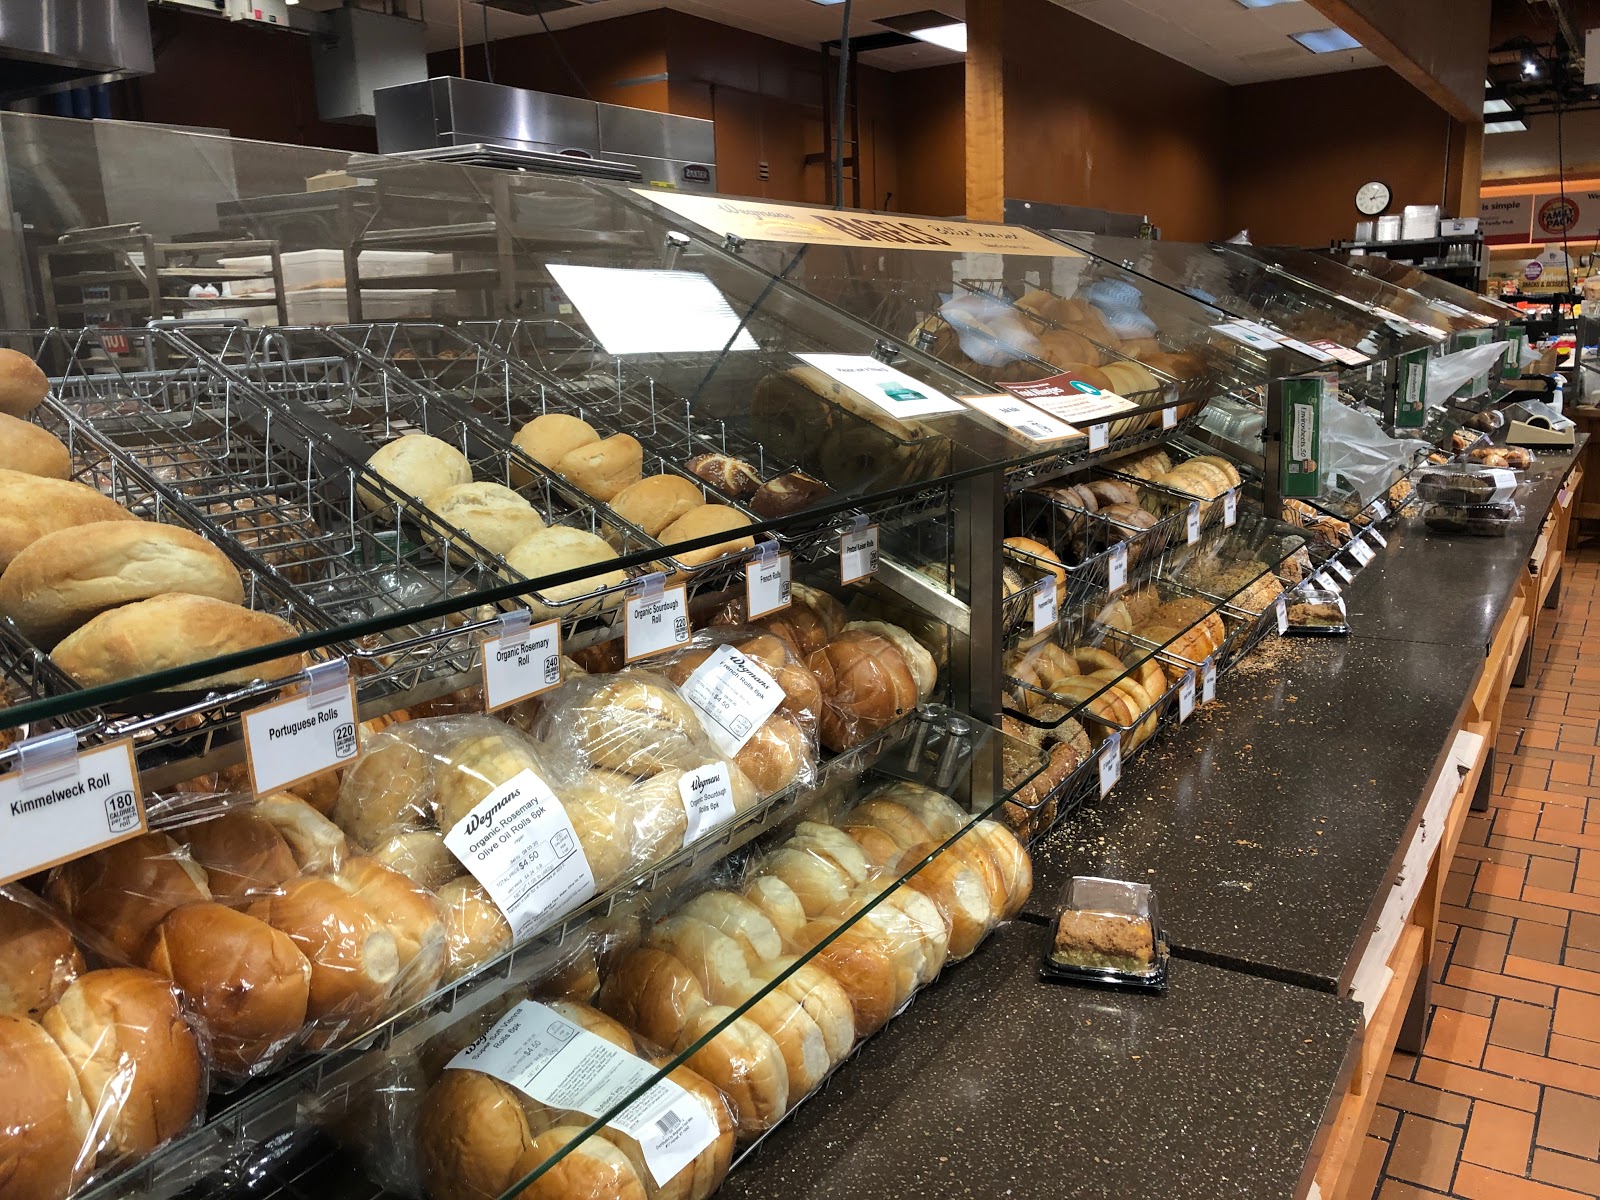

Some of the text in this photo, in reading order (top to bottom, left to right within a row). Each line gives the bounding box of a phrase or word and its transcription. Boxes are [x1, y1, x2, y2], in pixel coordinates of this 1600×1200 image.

[717, 202, 796, 221] Wegmans
[1482, 201, 1521, 212] is simple
[810, 214, 953, 247] BAGELS
[1546, 215, 1573, 229] PACK
[760, 570, 782, 584] French Rolls
[634, 599, 679, 619] Organic Sourdough
[651, 614, 662, 624] Roll
[675, 618, 687, 629] 220
[496, 638, 550, 662] Organic Rosemary
[518, 654, 530, 667] Roll
[545, 656, 558, 669] 240
[719, 660, 740, 679] French
[739, 676, 754, 691] Rolls
[753, 688, 765, 700] 6pk
[729, 654, 771, 690] Wegmans
[268, 708, 338, 741] Portuguese Rolls
[336, 724, 353, 740] 220
[336, 736, 355, 747] CALORIES
[10, 772, 111, 817] Kimmelweck Roll
[690, 774, 721, 796] Wegmans
[109, 793, 133, 811] 180
[703, 787, 727, 803] Sourdough
[109, 806, 136, 820] CALORIES
[463, 788, 521, 836] Wegmans
[709, 801, 720, 811] 6pk
[469, 796, 540, 854] Organic Rosemary
[477, 806, 547, 861] Olive Oil Rolls 6pk
[496, 850, 539, 888] TOTAL PRICE $4.50
[513, 891, 521, 899] NET
[471, 1041, 491, 1061] Super
[489, 1027, 504, 1043] Soft
[502, 1008, 523, 1030] Vienna
[493, 1022, 522, 1049] Rolls 6pk
[523, 1039, 542, 1057] $4.50
[593, 1095, 613, 1113] Nutrition
[611, 1085, 625, 1096] Facts
